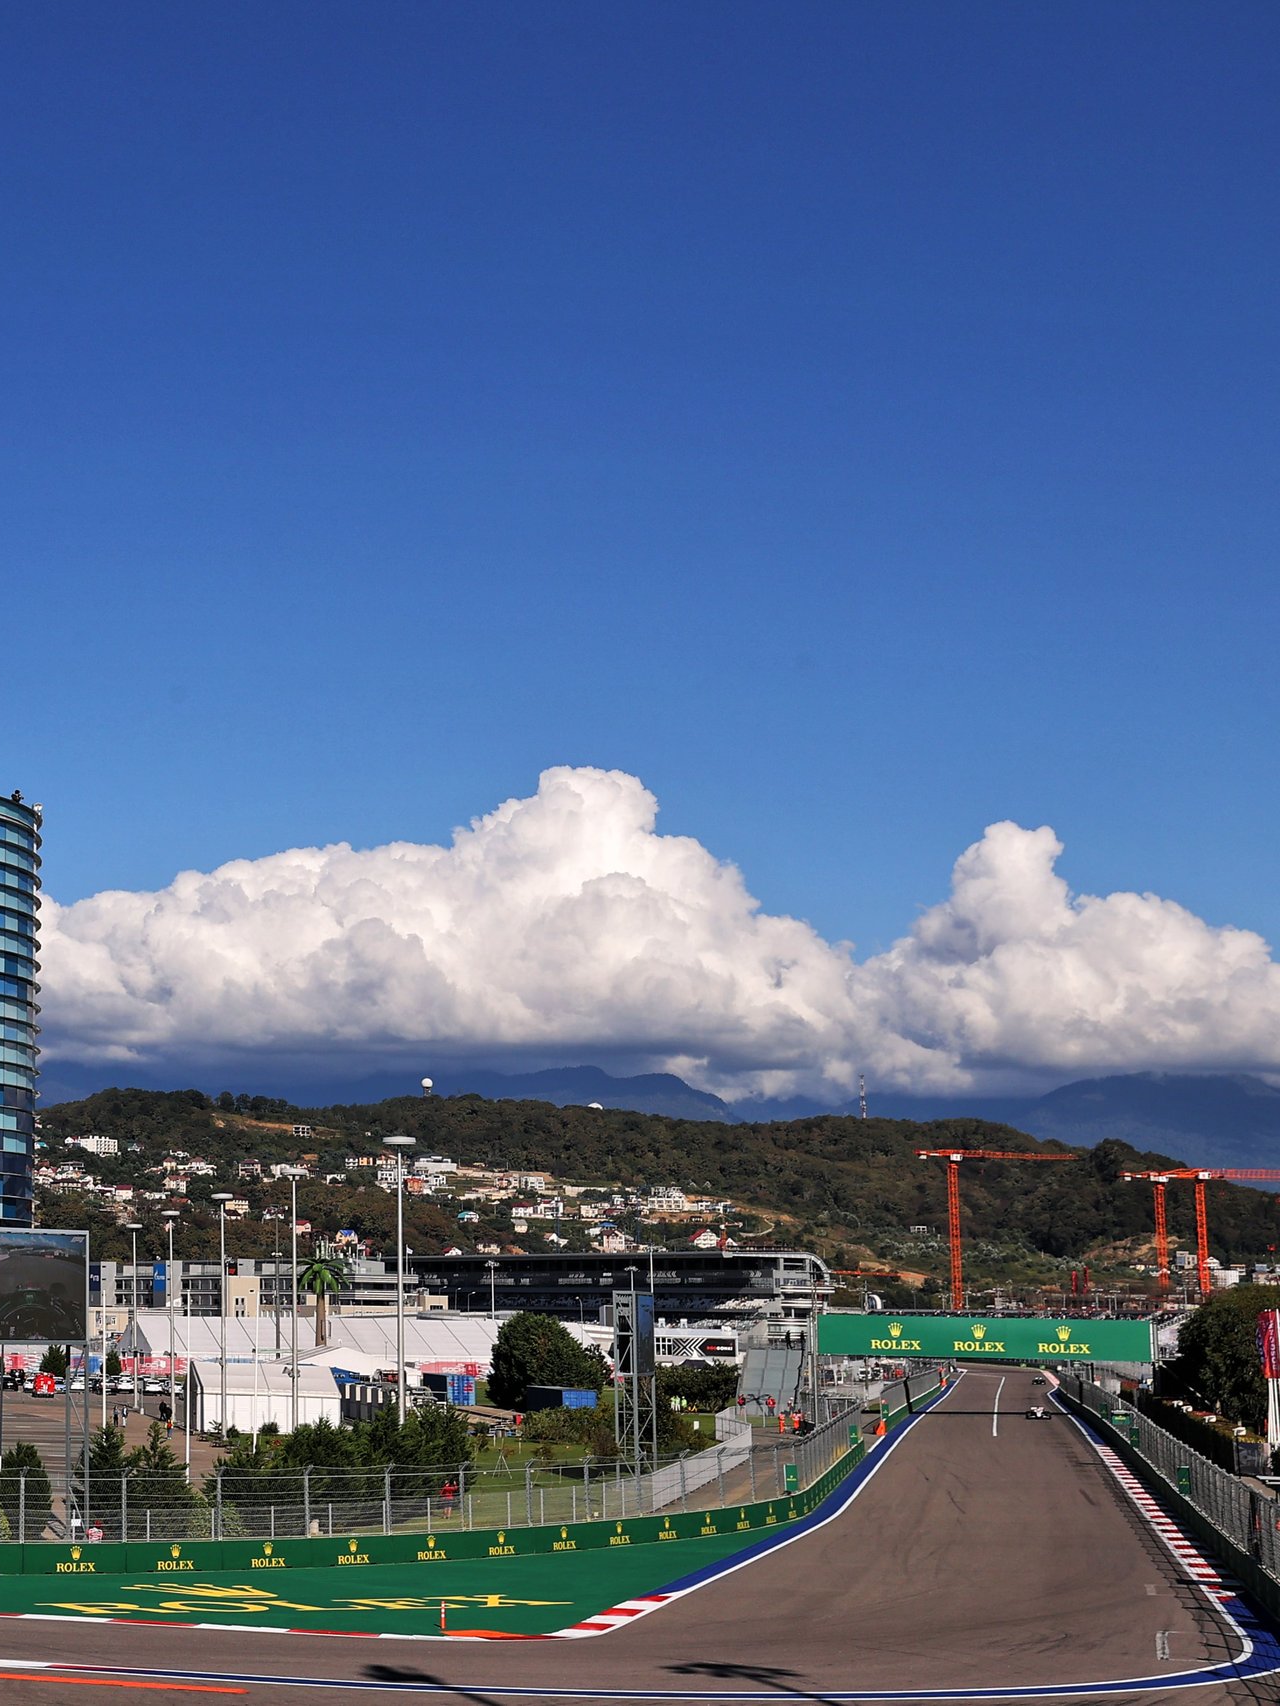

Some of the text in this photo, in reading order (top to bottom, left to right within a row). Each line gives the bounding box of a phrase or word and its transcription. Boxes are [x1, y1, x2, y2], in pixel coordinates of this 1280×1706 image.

[870, 1339, 921, 1350] ROLEX
[953, 1341, 1005, 1352] ROLEX
[1037, 1343, 1091, 1354] ROLEX
[609, 1535, 630, 1545] ROLEX
[553, 1540, 576, 1551] ROLEX
[417, 1551, 446, 1561] ROLEX
[488, 1546, 515, 1556] ROLEX
[157, 1560, 193, 1570] ROLEX
[251, 1558, 286, 1568] ROLEX
[337, 1555, 369, 1565] ROLEX
[56, 1562, 95, 1572] ROLEX
[34, 1594, 575, 1614] ROLEX
